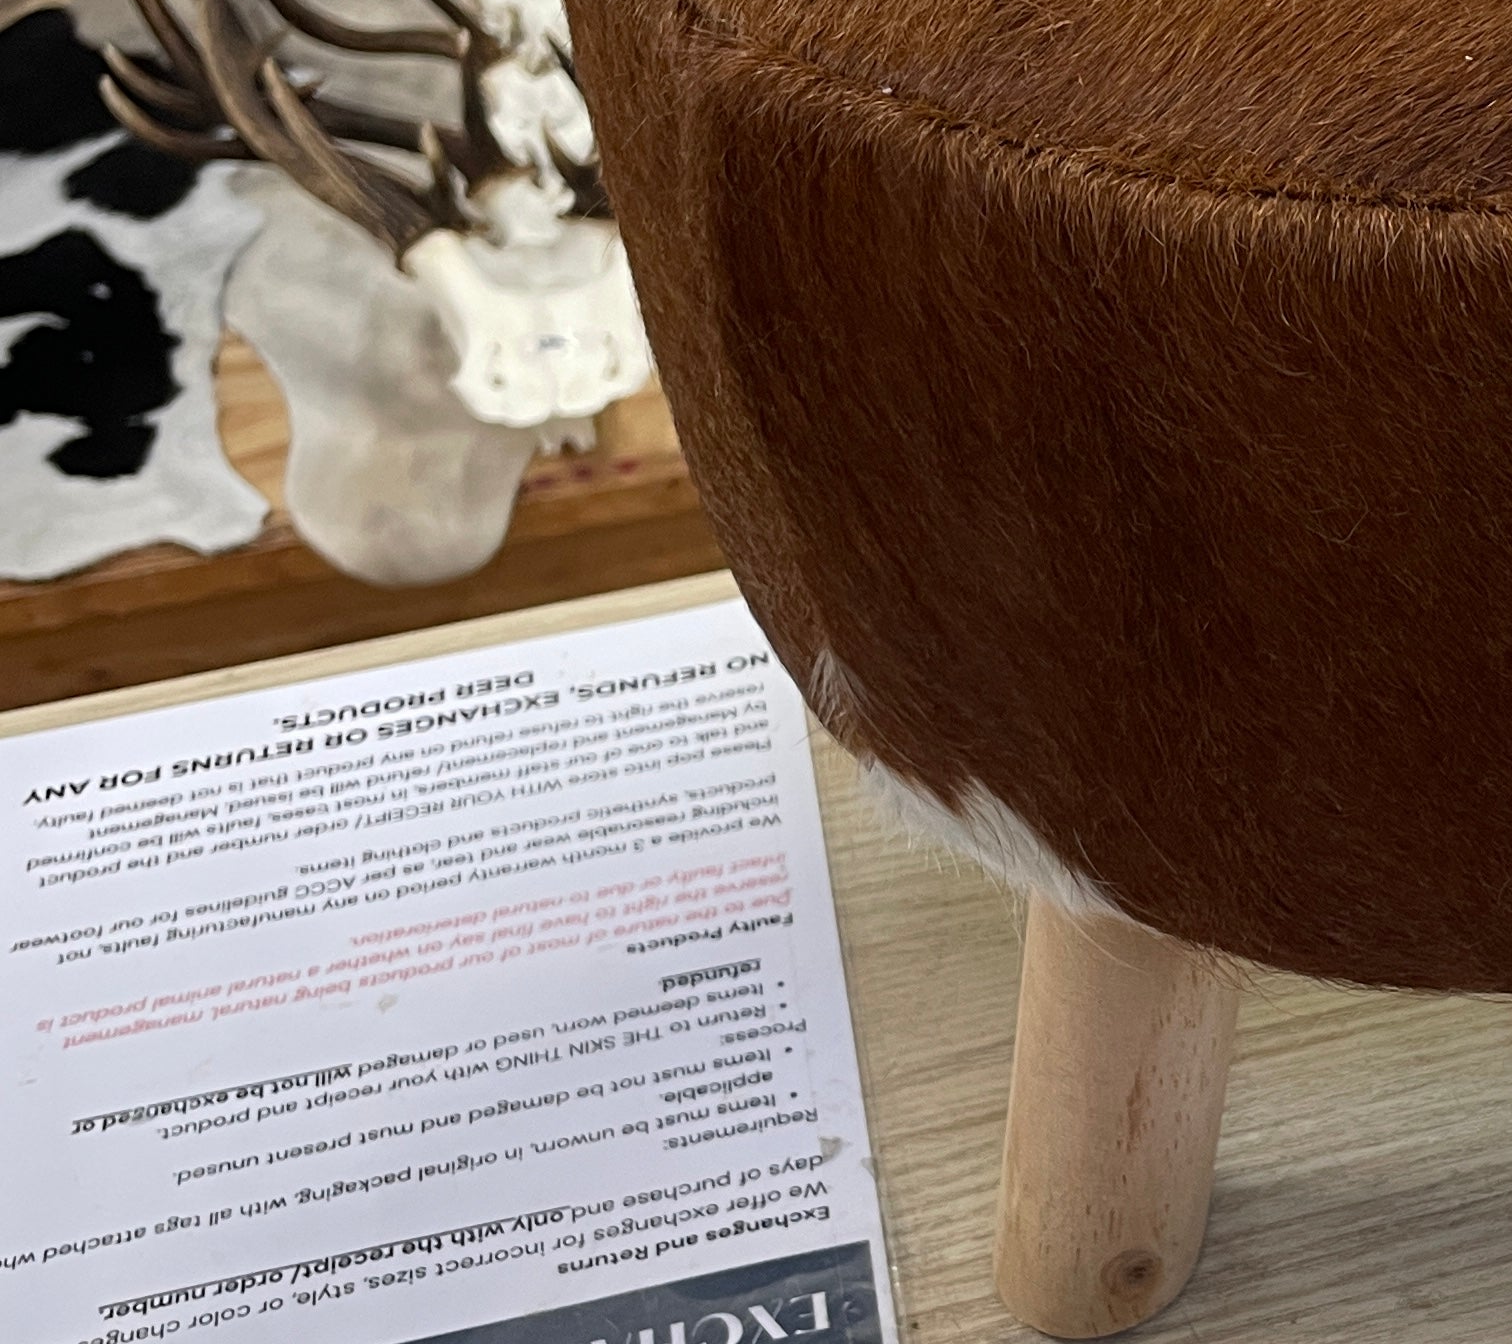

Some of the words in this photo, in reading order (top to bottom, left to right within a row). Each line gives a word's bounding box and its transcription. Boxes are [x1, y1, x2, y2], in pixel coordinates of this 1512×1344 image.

[724, 651, 770, 672] NO
[454, 671, 535, 699] DEER
[568, 661, 717, 700] REFUNDS,
[272, 688, 446, 732] PRODUCTS.
[375, 691, 561, 738] EXCHANGES
[322, 727, 369, 748] OR
[170, 736, 315, 777] RETURNS
[97, 765, 163, 791] FOR
[21, 778, 92, 806] ANY
[727, 910, 794, 935] Faulty
[625, 925, 723, 955] Products
[705, 982, 764, 1004] Items
[612, 994, 701, 1026] deemed
[696, 1003, 767, 1029] Return
[492, 1026, 545, 1051] used
[622, 1025, 663, 1047] THE
[668, 1019, 692, 1035] to
[718, 1017, 808, 1047] Process:
[464, 1038, 487, 1053] or
[567, 1034, 616, 1058] SKIN
[356, 1043, 459, 1078] damaged
[442, 1060, 490, 1082] with
[494, 1046, 562, 1073] THING
[711, 1047, 772, 1071] Items
[268, 1073, 310, 1095] not
[313, 1064, 352, 1087] will
[387, 1068, 438, 1092] your
[609, 1074, 647, 1093] not
[651, 1061, 707, 1085] must
[234, 1082, 266, 1101] be
[304, 1081, 383, 1111] receipt
[575, 1082, 605, 1099] be
[255, 1100, 299, 1123] and
[467, 1089, 571, 1125] damaged
[716, 1092, 777, 1116] Items
[70, 1116, 97, 1135] or
[419, 1112, 462, 1134] and
[620, 1119, 650, 1137] be
[655, 1106, 711, 1131] must
[661, 1105, 819, 1152] Requirements:
[358, 1121, 415, 1146] must
[265, 1131, 352, 1166] present
[503, 1146, 524, 1162] in
[417, 1150, 498, 1183] original
[737, 1167, 762, 1187] of
[767, 1153, 825, 1178] days
[621, 1169, 732, 1209] purchase
[725, 1189, 782, 1214] offer
[787, 1179, 828, 1200] We
[207, 1207, 233, 1227] all
[239, 1196, 288, 1219] with
[507, 1205, 565, 1234] only
[568, 1198, 616, 1224] and
[153, 1213, 201, 1236] tags
[447, 1221, 506, 1248] with
[592, 1201, 720, 1243] exchanges
[704, 1203, 831, 1243] Exchanges
[41, 1226, 147, 1264] attached
[399, 1234, 445, 1257] the
[551, 1232, 586, 1252] for
[654, 1233, 699, 1257] and
[434, 1240, 545, 1278] incorrect
[556, 1244, 649, 1276] Returns
[209, 1268, 284, 1298] order
[187, 1304, 252, 1331] color
[257, 1297, 284, 1315] or
